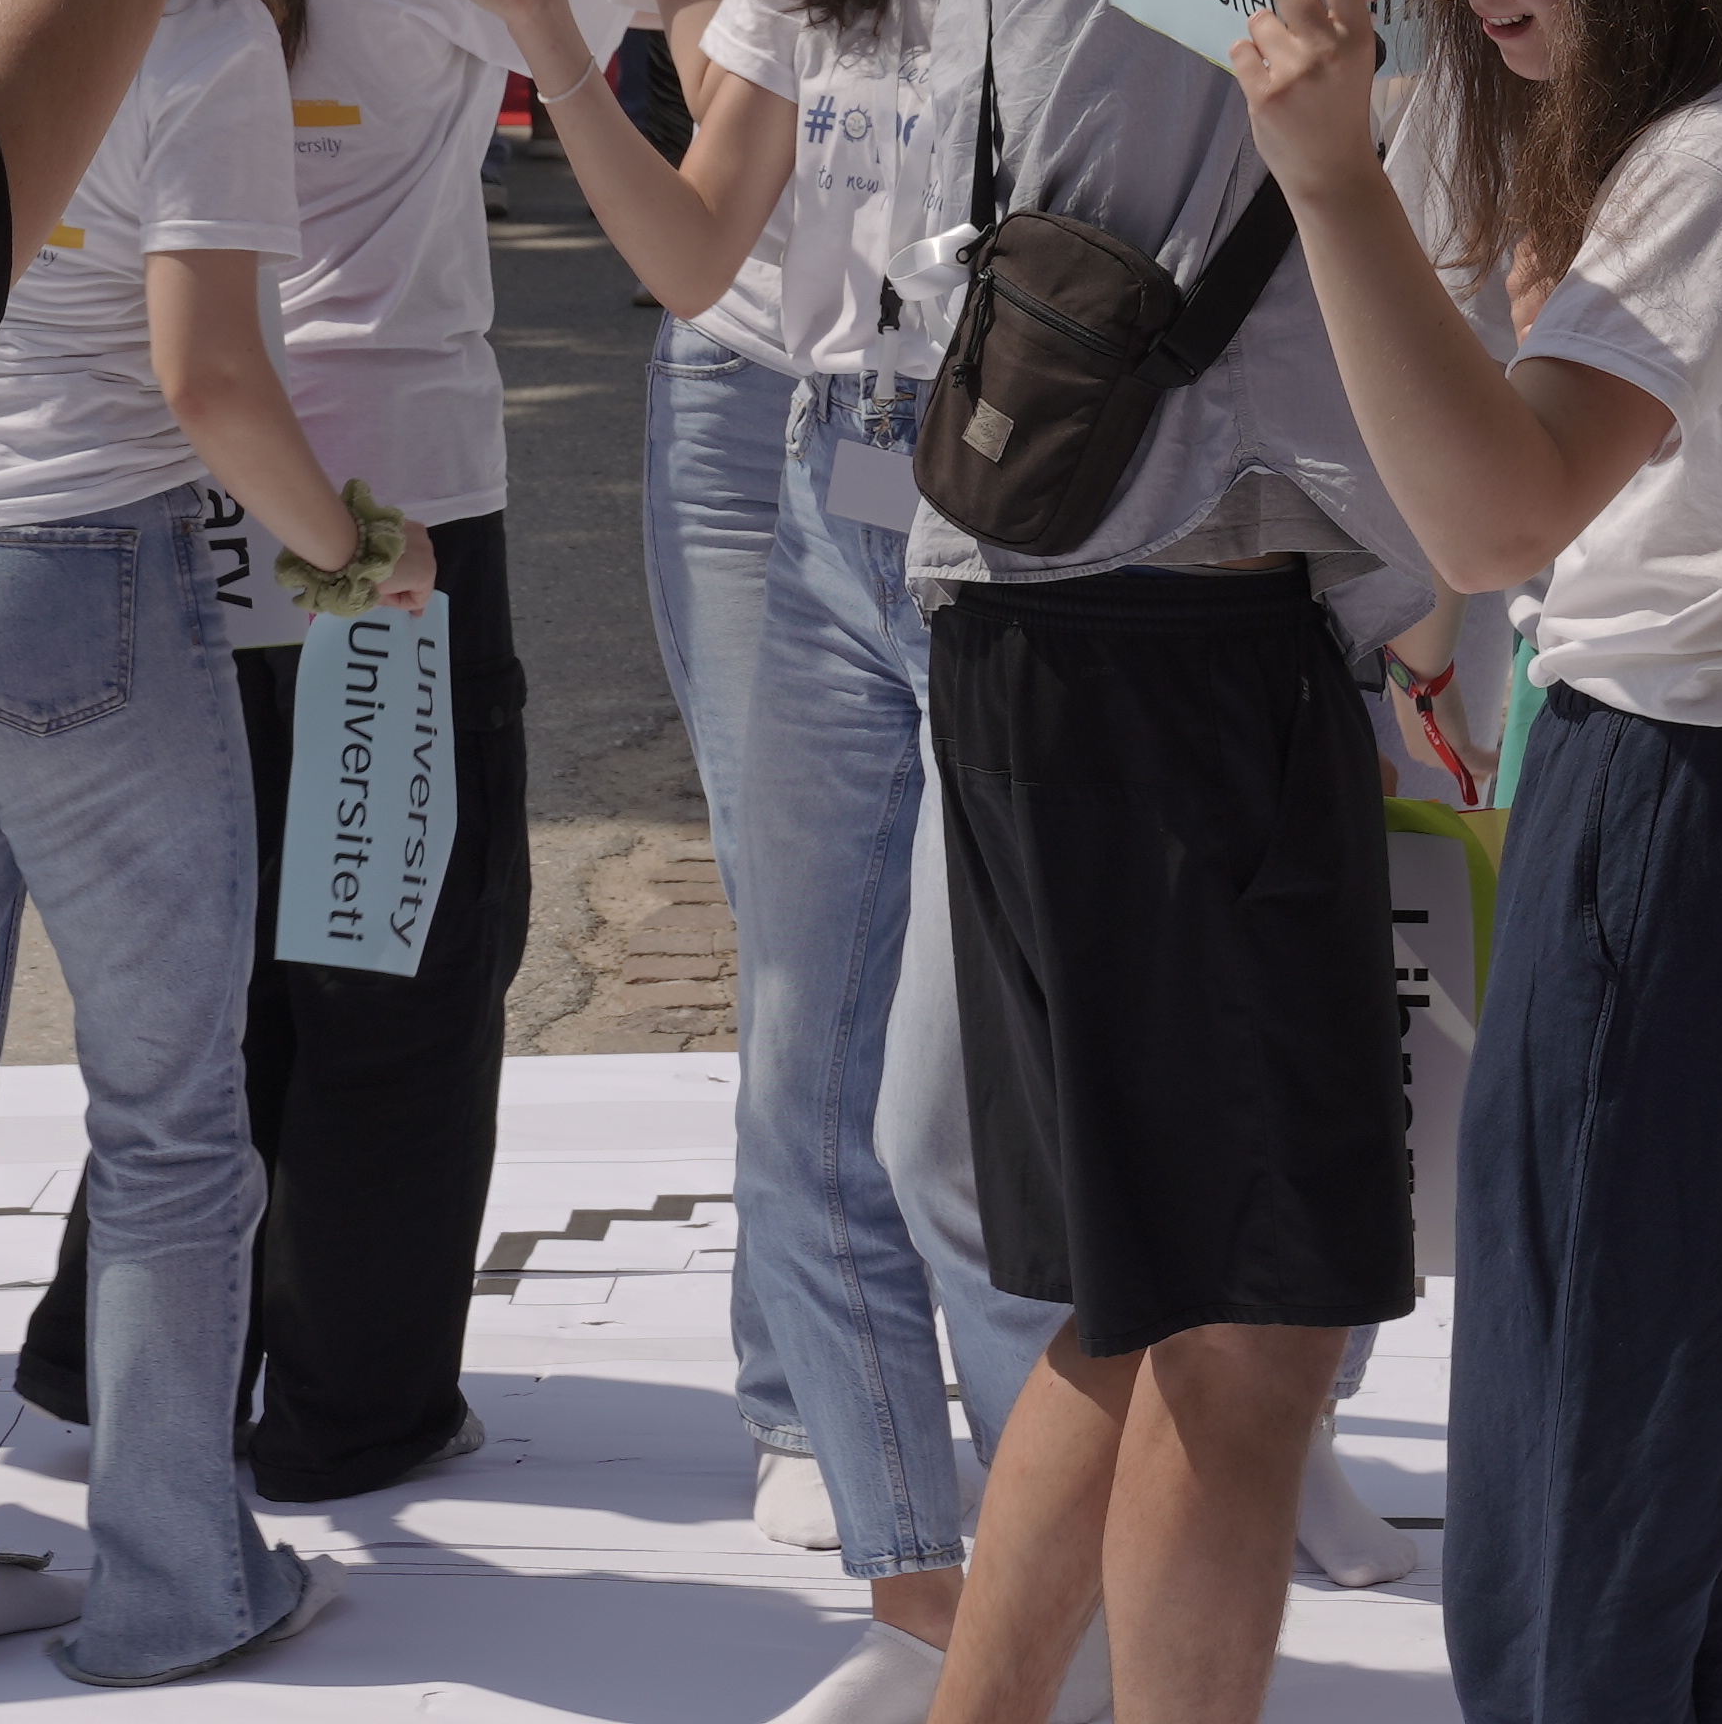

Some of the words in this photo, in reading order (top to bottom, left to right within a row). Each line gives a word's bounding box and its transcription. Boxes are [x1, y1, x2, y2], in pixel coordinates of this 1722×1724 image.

[294, 137, 342, 158] ersity
[327, 621, 390, 942] Universiteti
[390, 638, 438, 948] University
